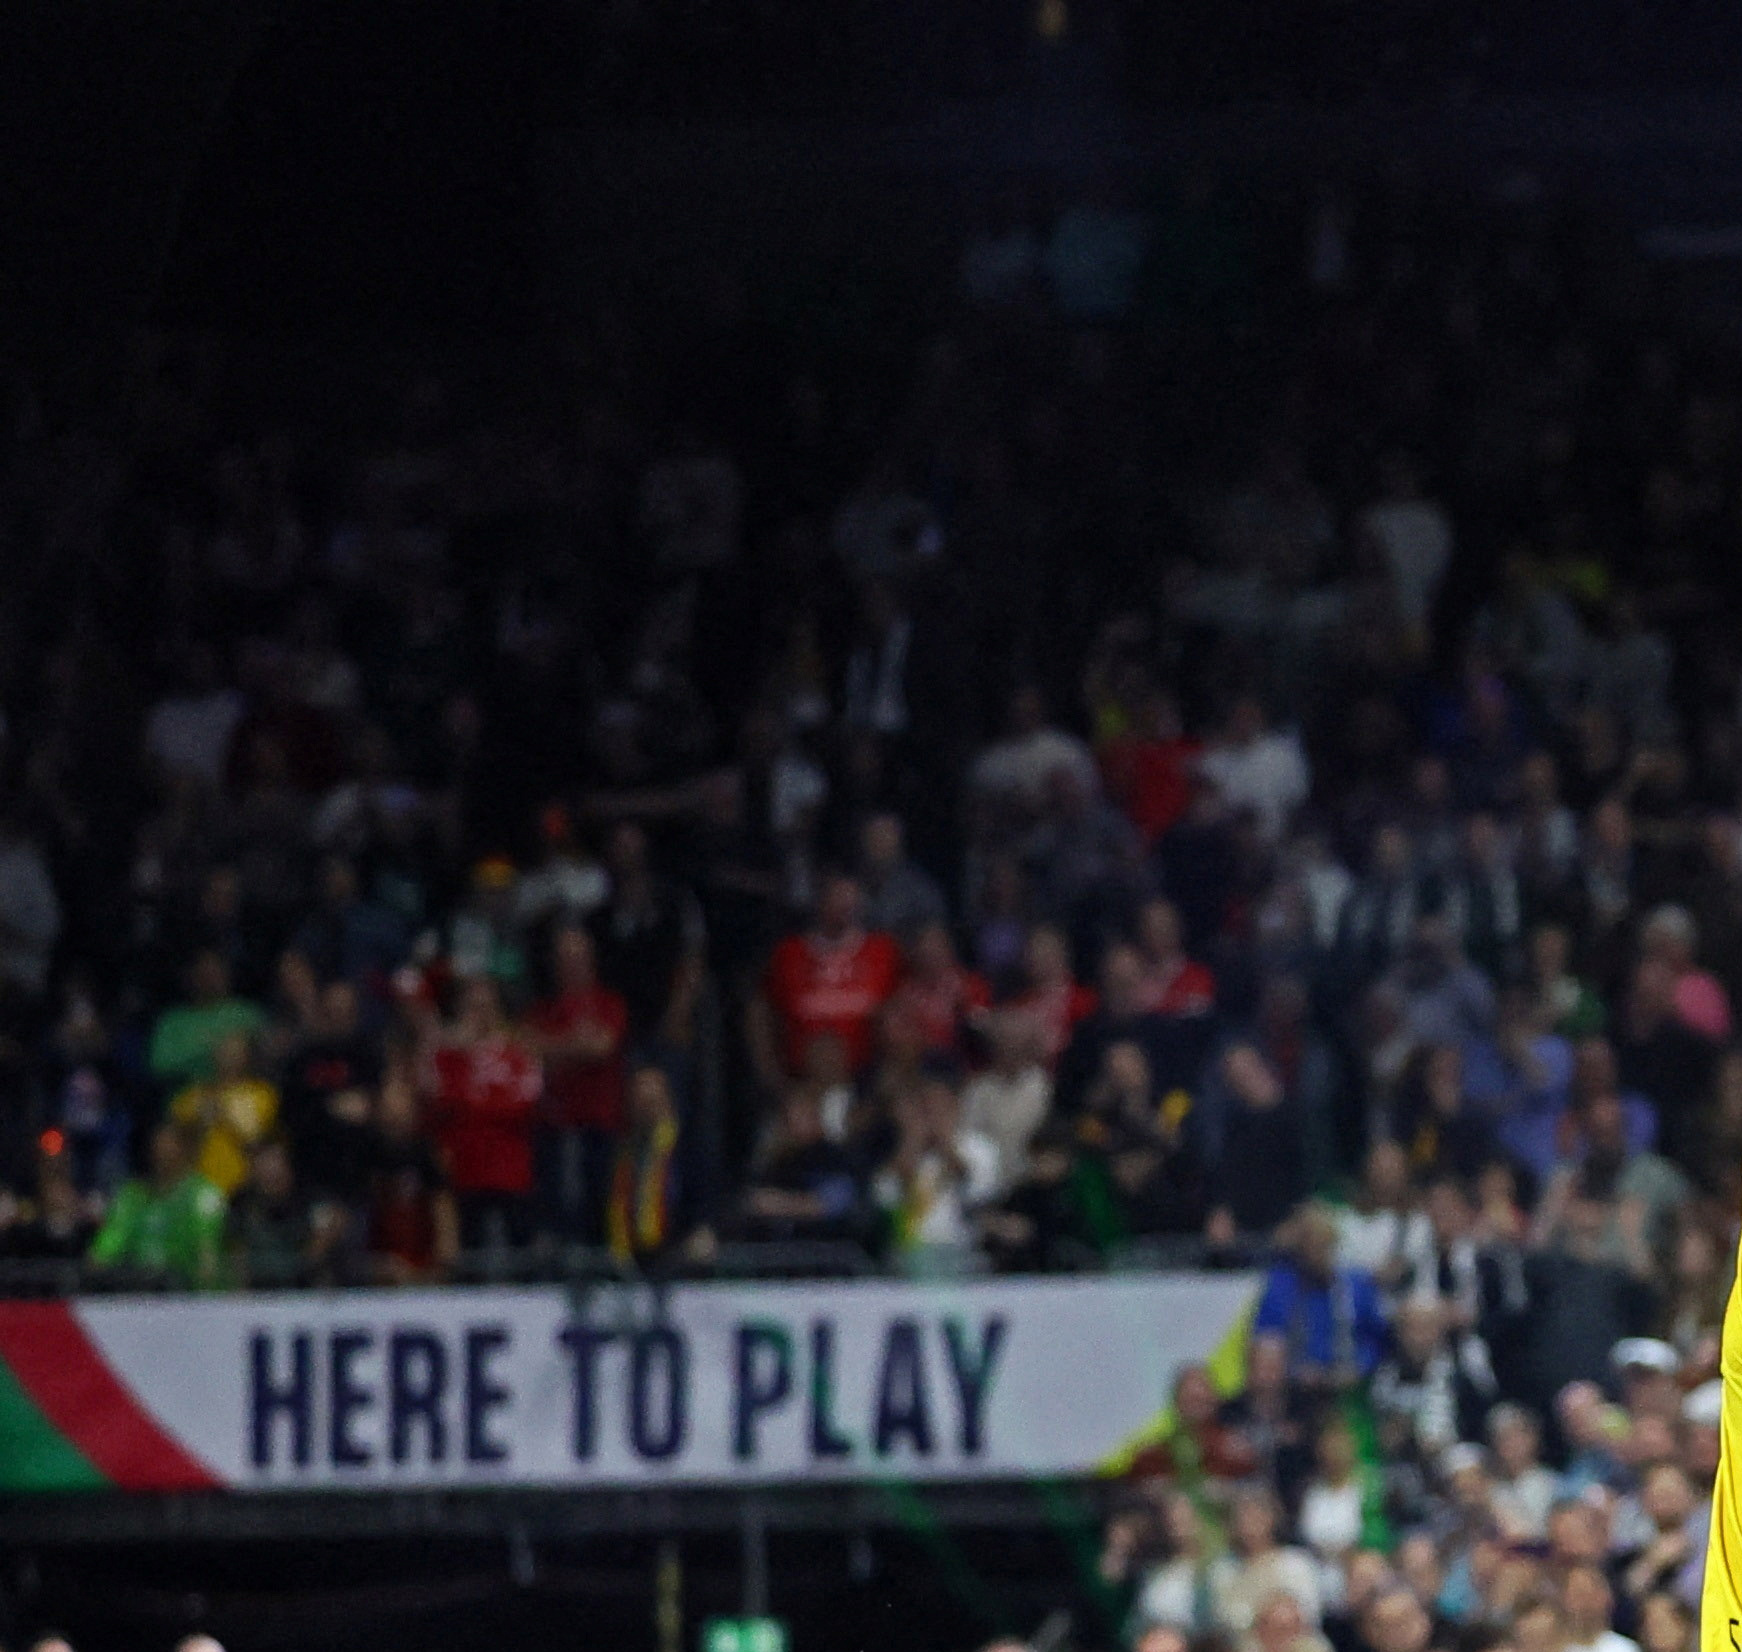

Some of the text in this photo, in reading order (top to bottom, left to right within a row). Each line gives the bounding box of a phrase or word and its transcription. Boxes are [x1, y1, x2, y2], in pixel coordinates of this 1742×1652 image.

[249, 1314, 1006, 1468] HERE TO PLAY
